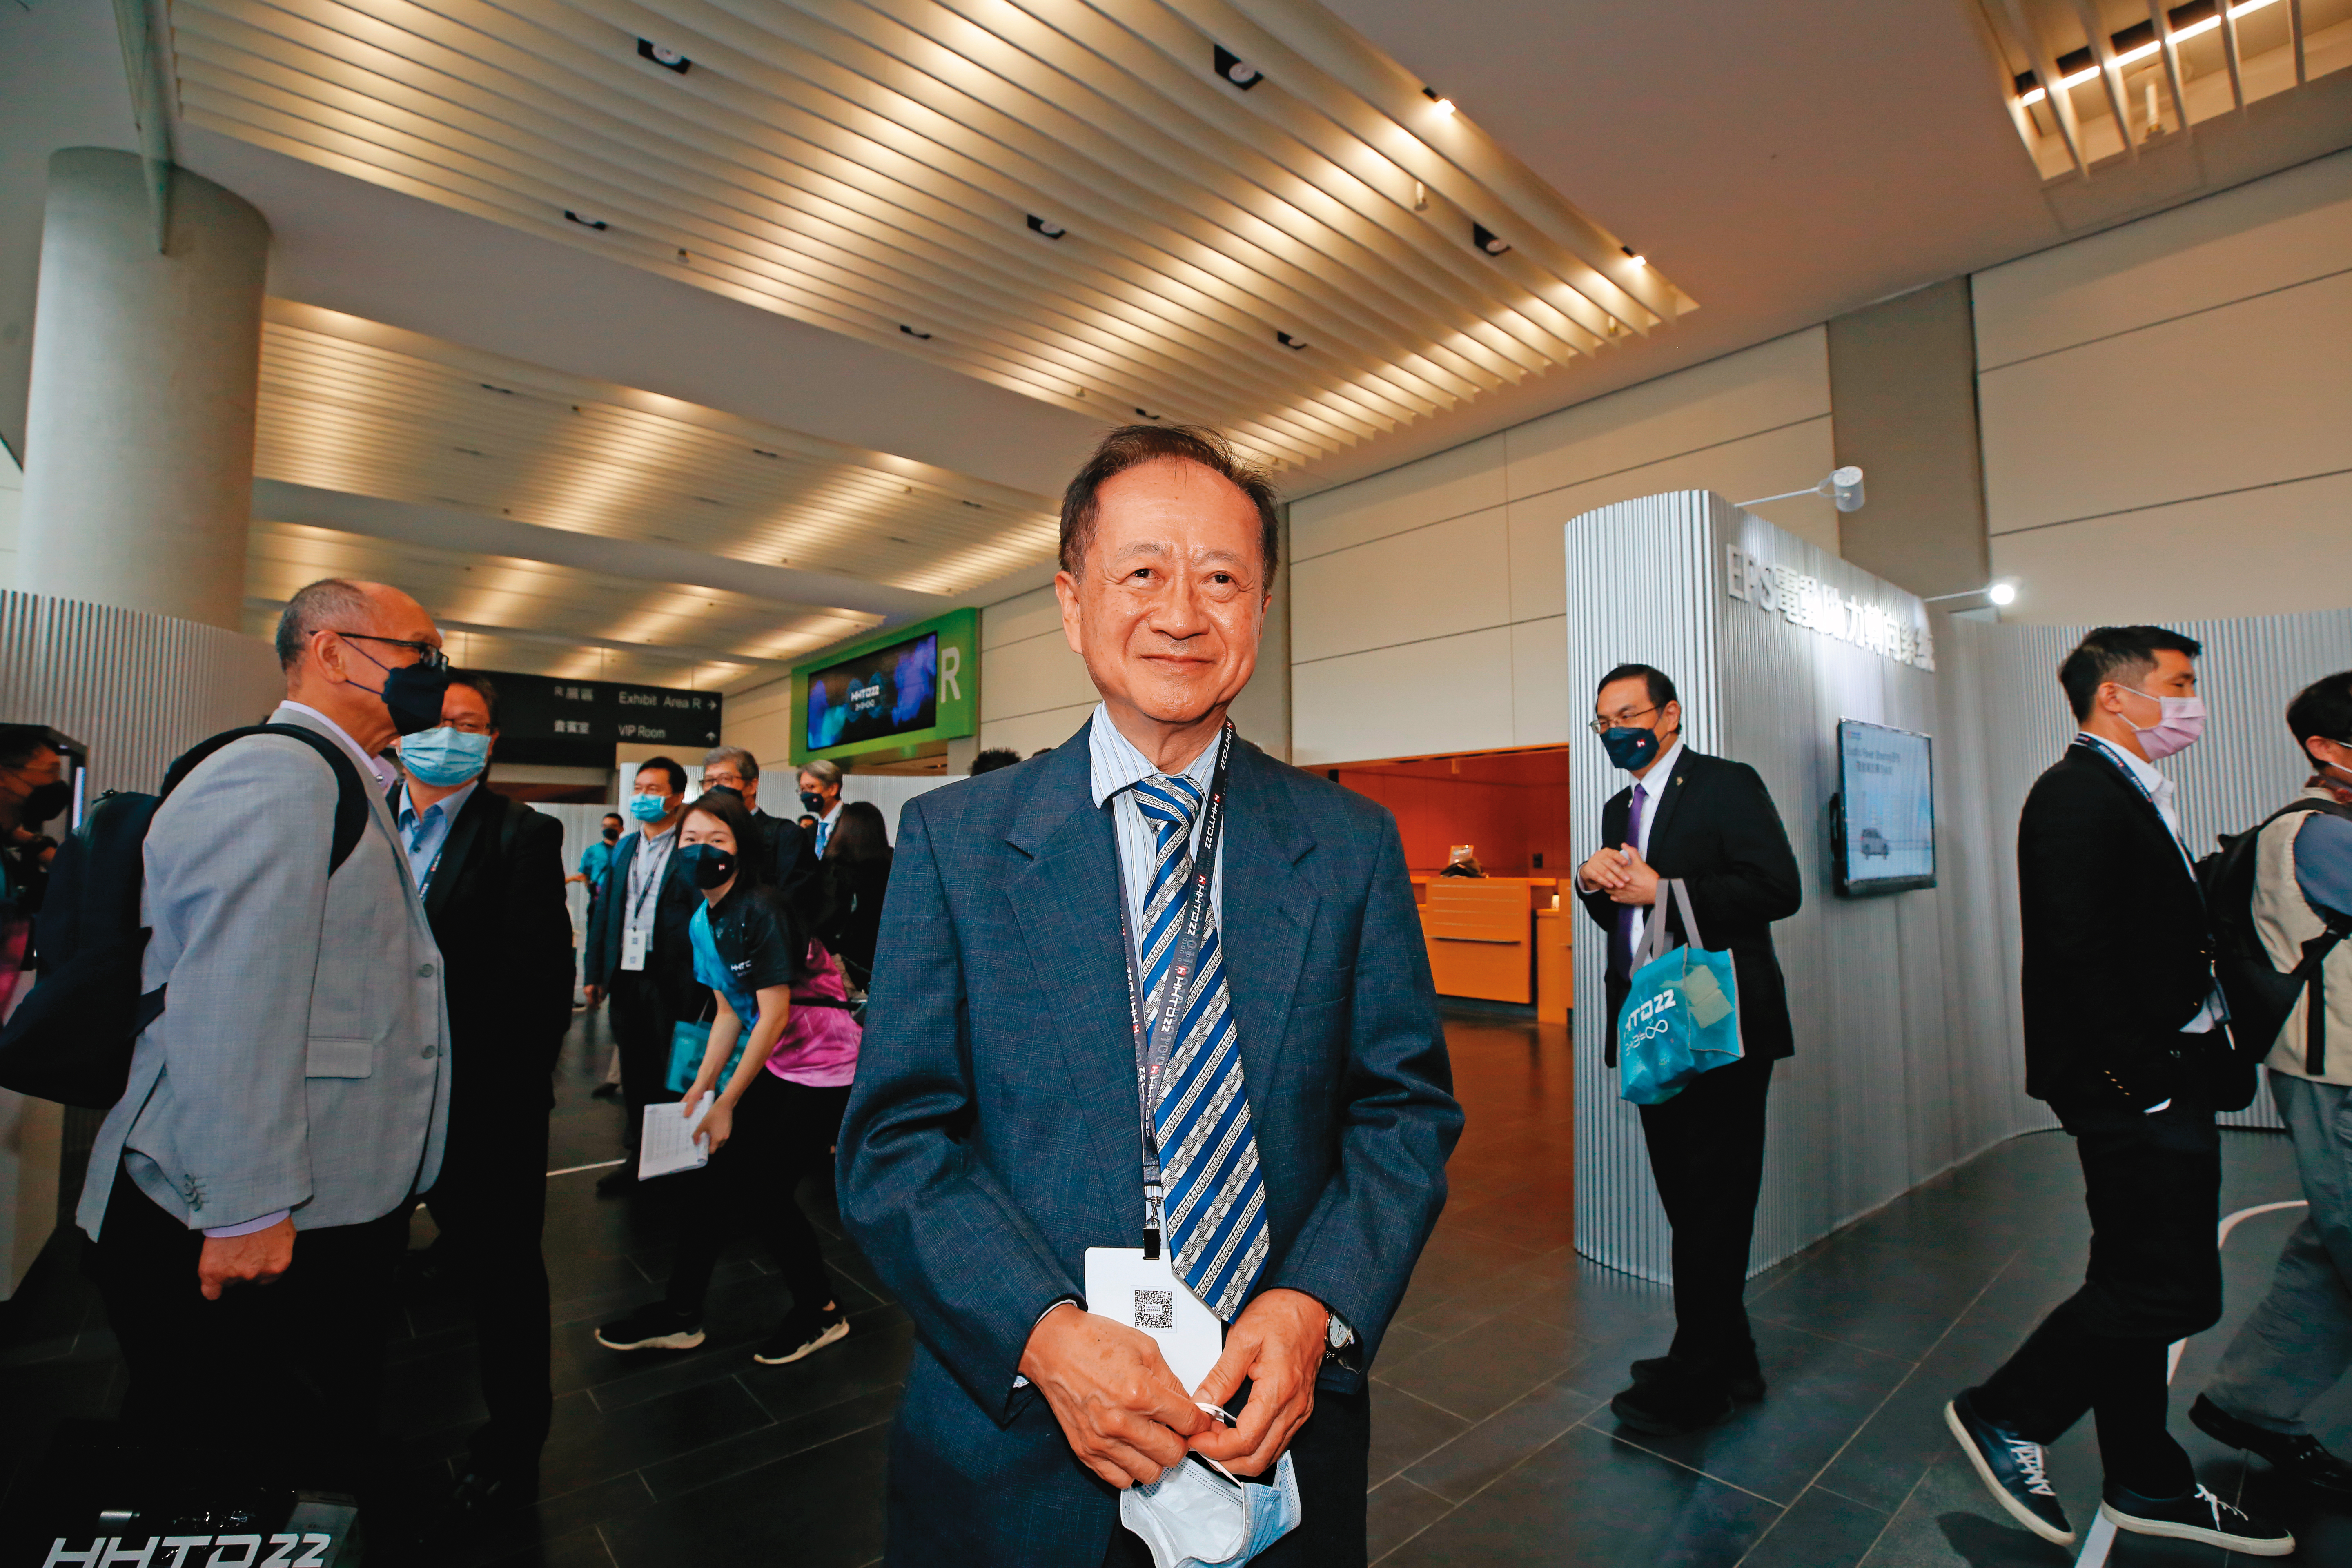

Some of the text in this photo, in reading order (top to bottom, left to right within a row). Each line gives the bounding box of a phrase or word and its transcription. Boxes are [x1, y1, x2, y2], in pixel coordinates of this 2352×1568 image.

[940, 646, 961, 704] R
[619, 691, 702, 710] Exhibit Area R
[618, 724, 666, 739] VIP Room
